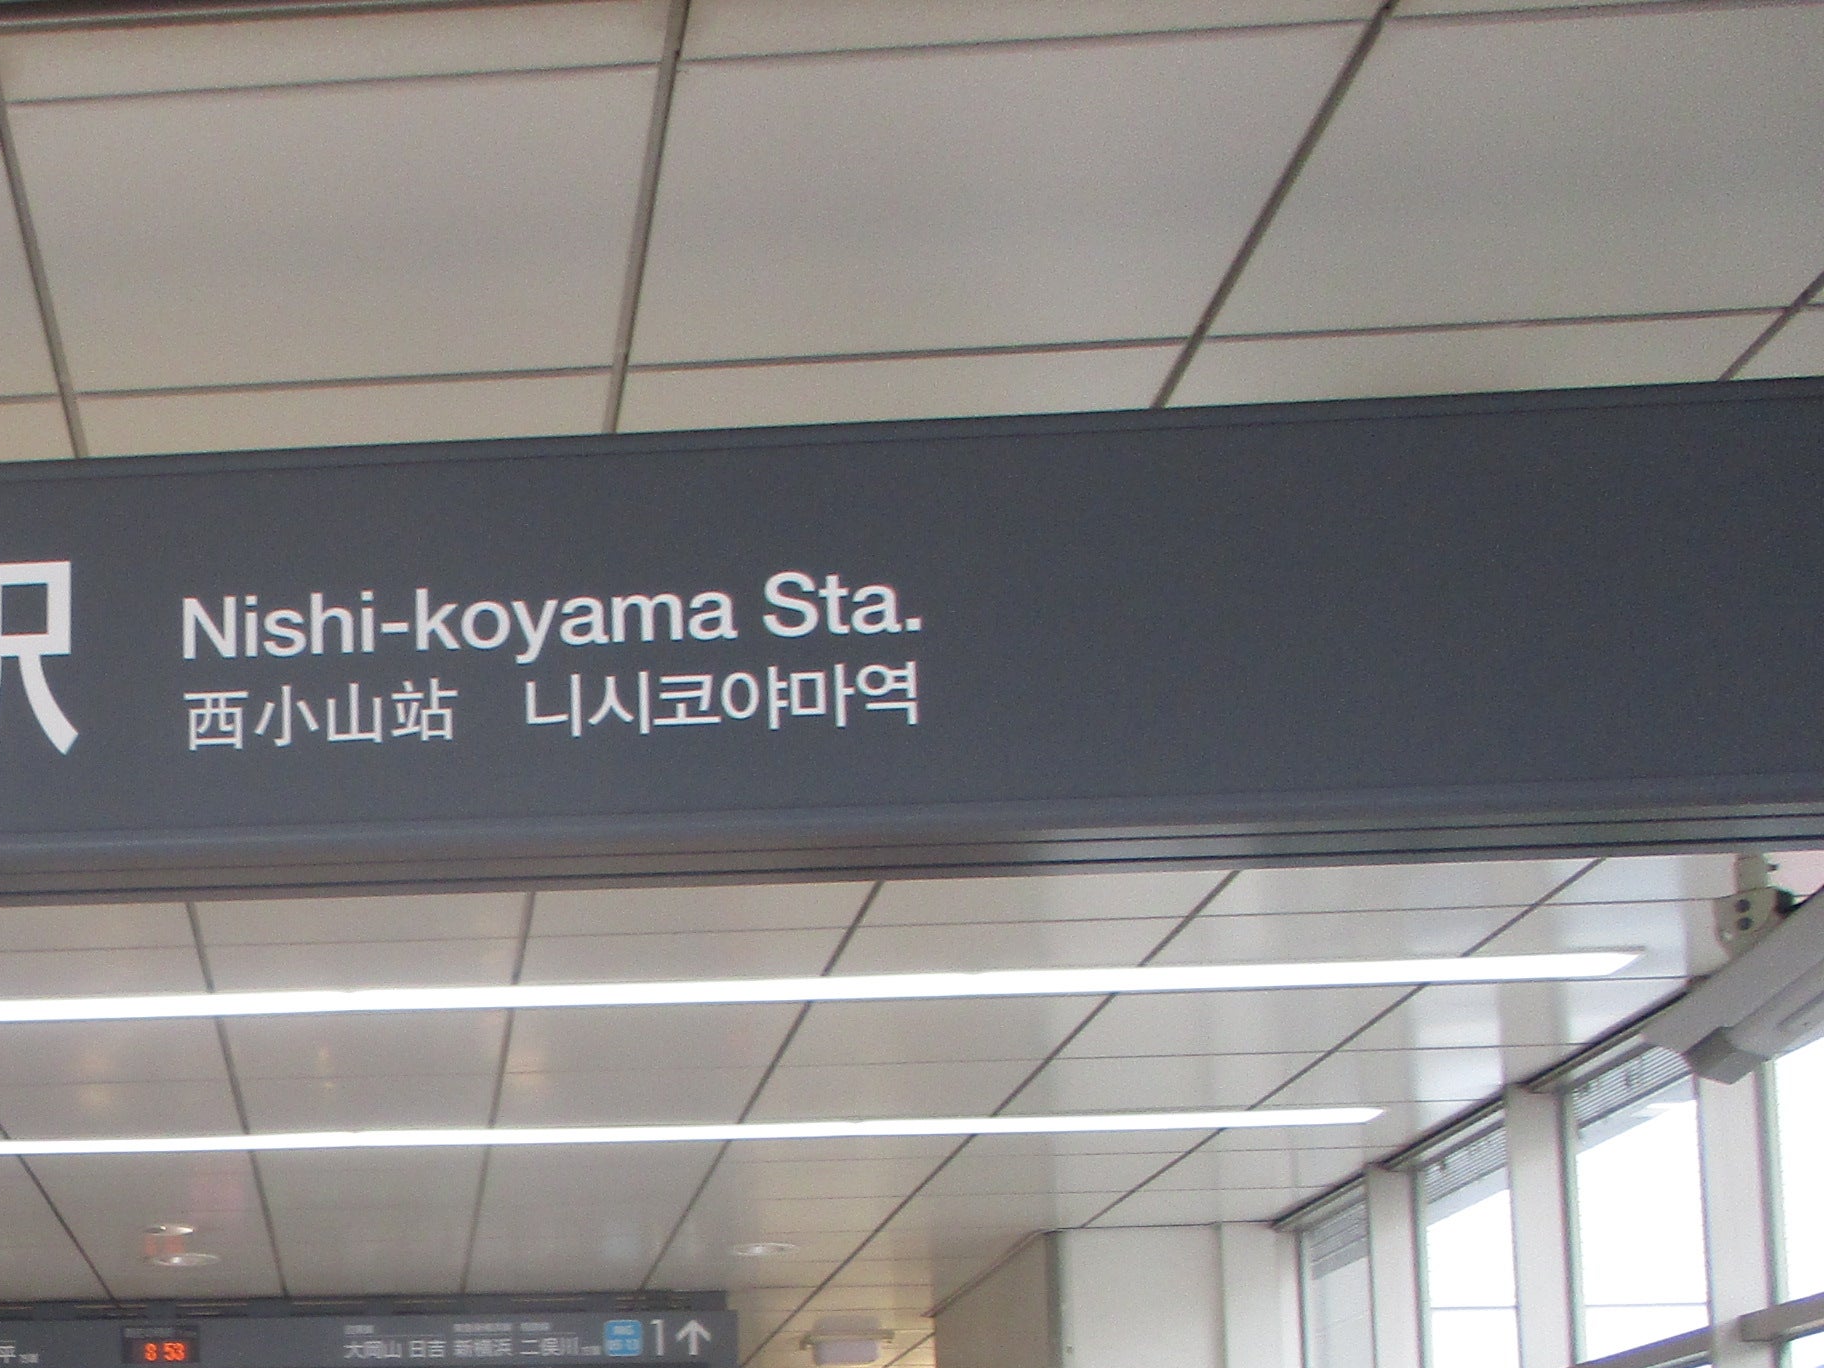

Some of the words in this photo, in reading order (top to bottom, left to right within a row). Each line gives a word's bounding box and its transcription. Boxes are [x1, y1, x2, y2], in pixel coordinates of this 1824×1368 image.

[182, 588, 738, 665] Nishi-koyama
[762, 570, 923, 639] Sta.
[183, 677, 458, 752] 西小山站
[524, 660, 920, 738] 니시코야마역
[650, 1319, 664, 1356] 1
